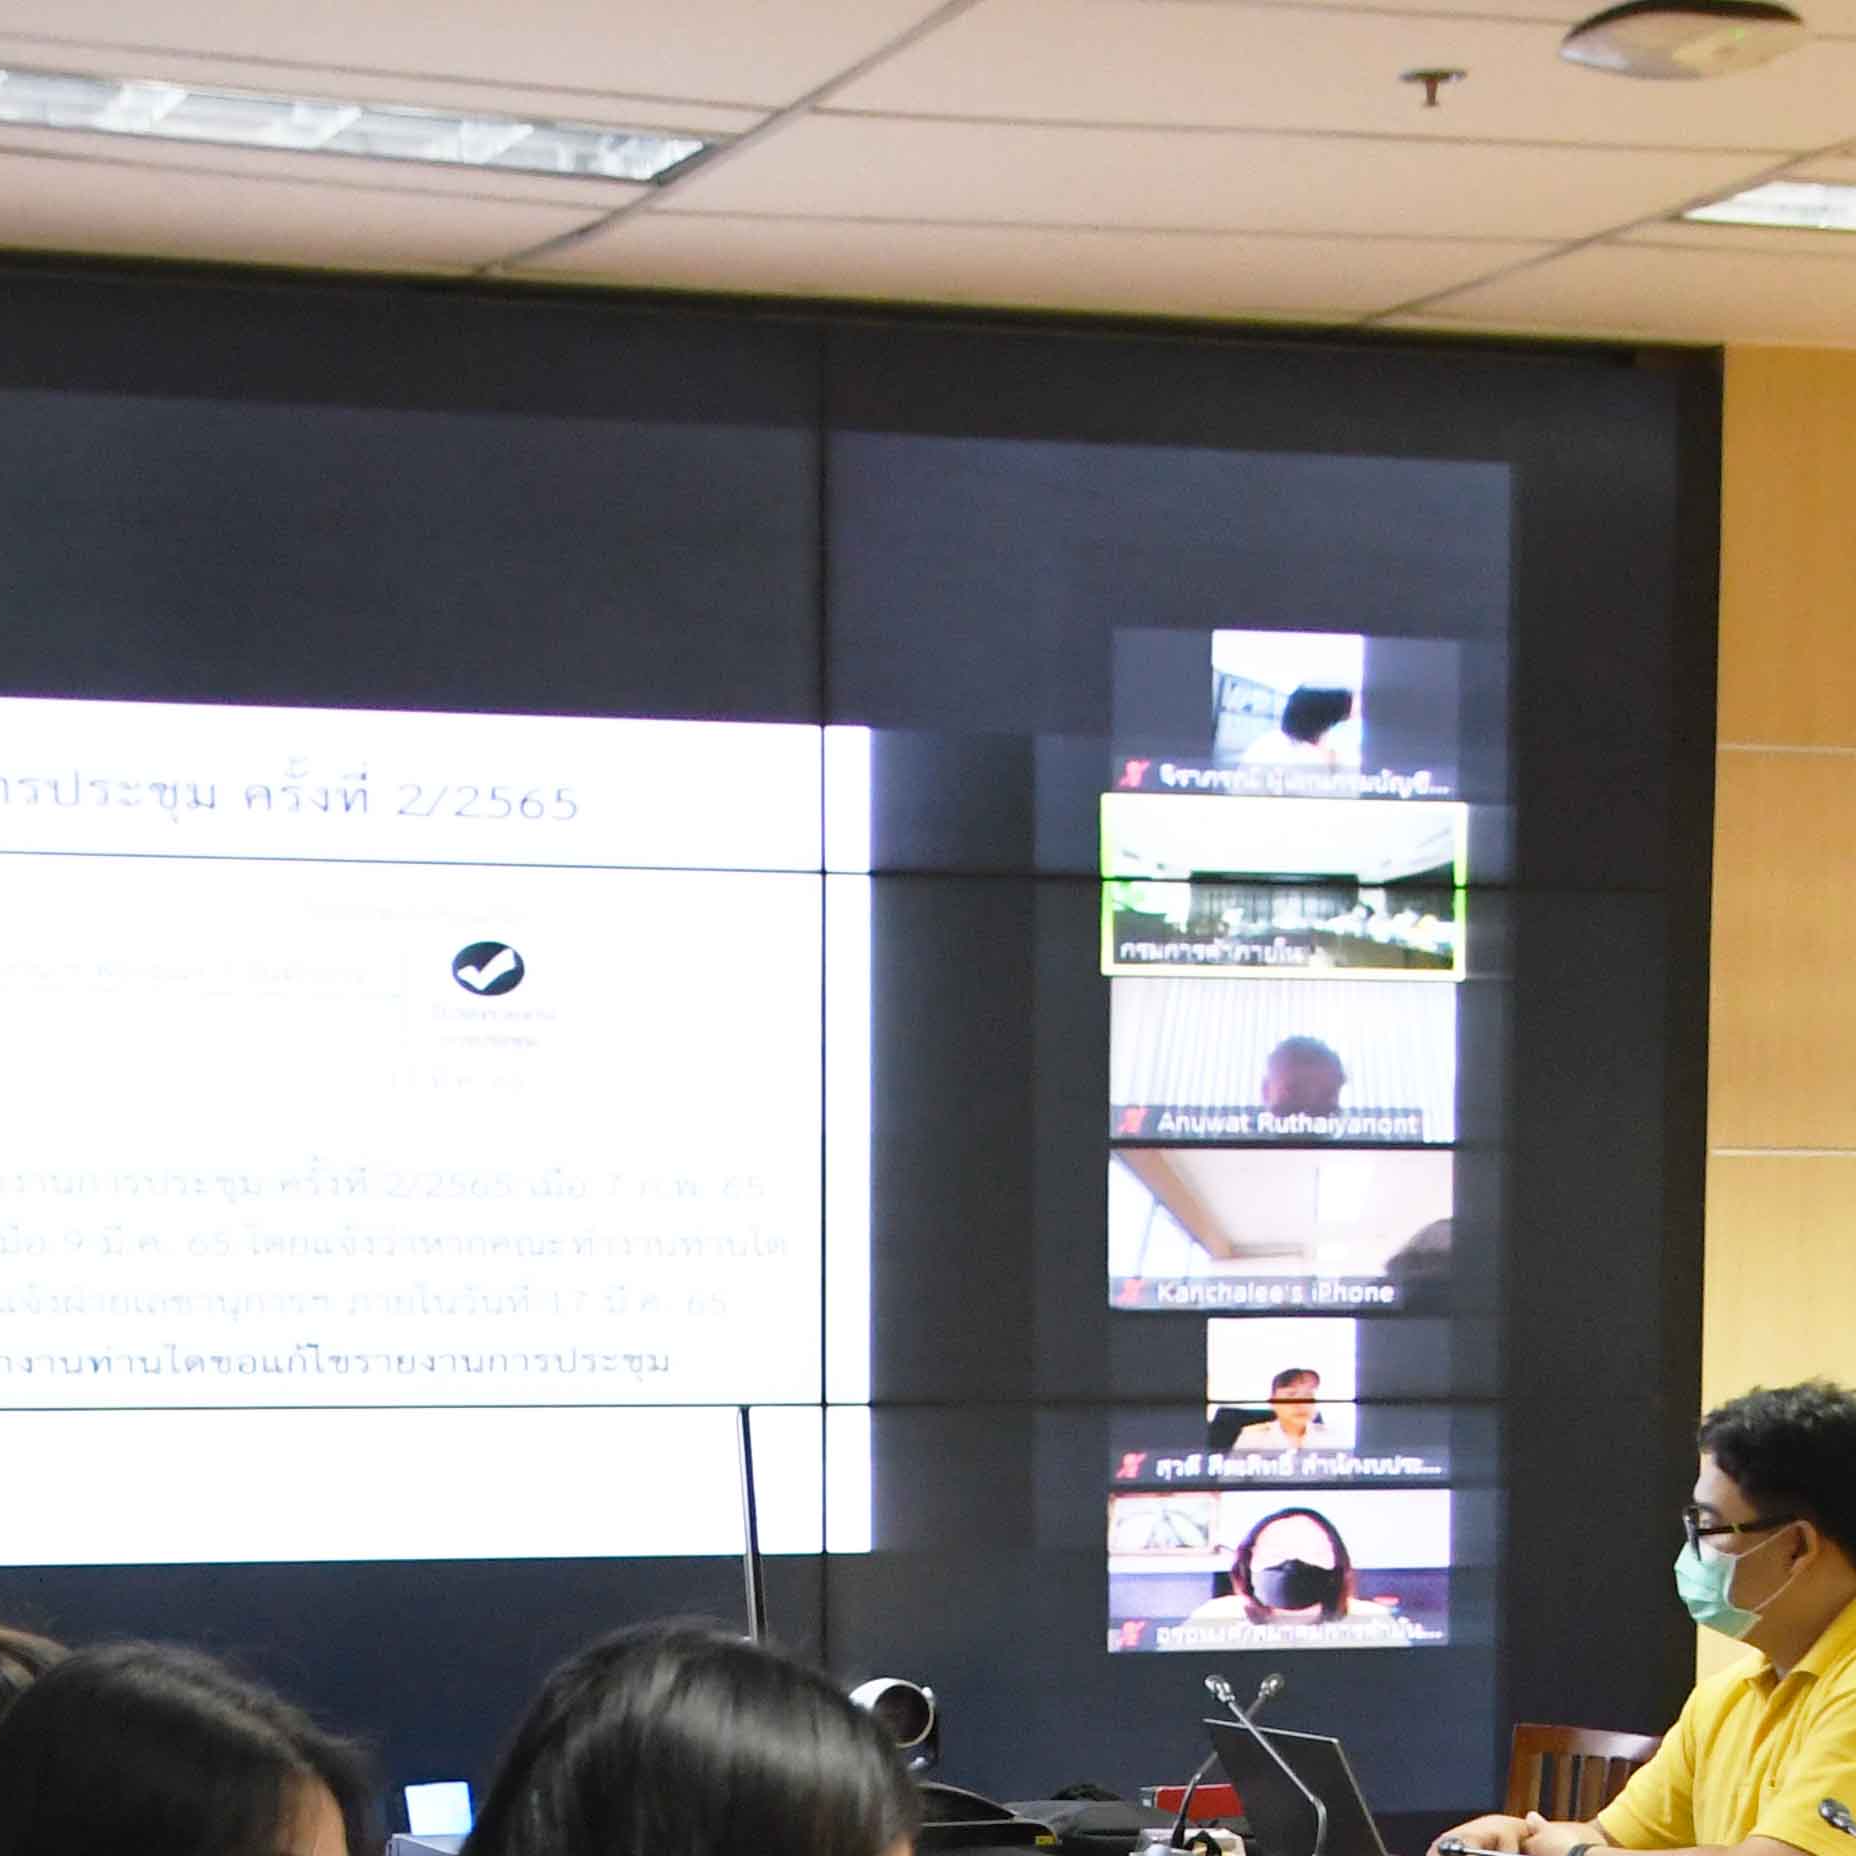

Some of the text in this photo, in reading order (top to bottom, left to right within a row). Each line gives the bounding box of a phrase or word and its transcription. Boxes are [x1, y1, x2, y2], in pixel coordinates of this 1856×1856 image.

[245, 755, 369, 814] ครั้งที่
[397, 782, 580, 821] 2/2565
[1157, 1111, 1250, 1134] Anuwat
[1157, 1281, 1395, 1304] Kanchalee's iPhone
